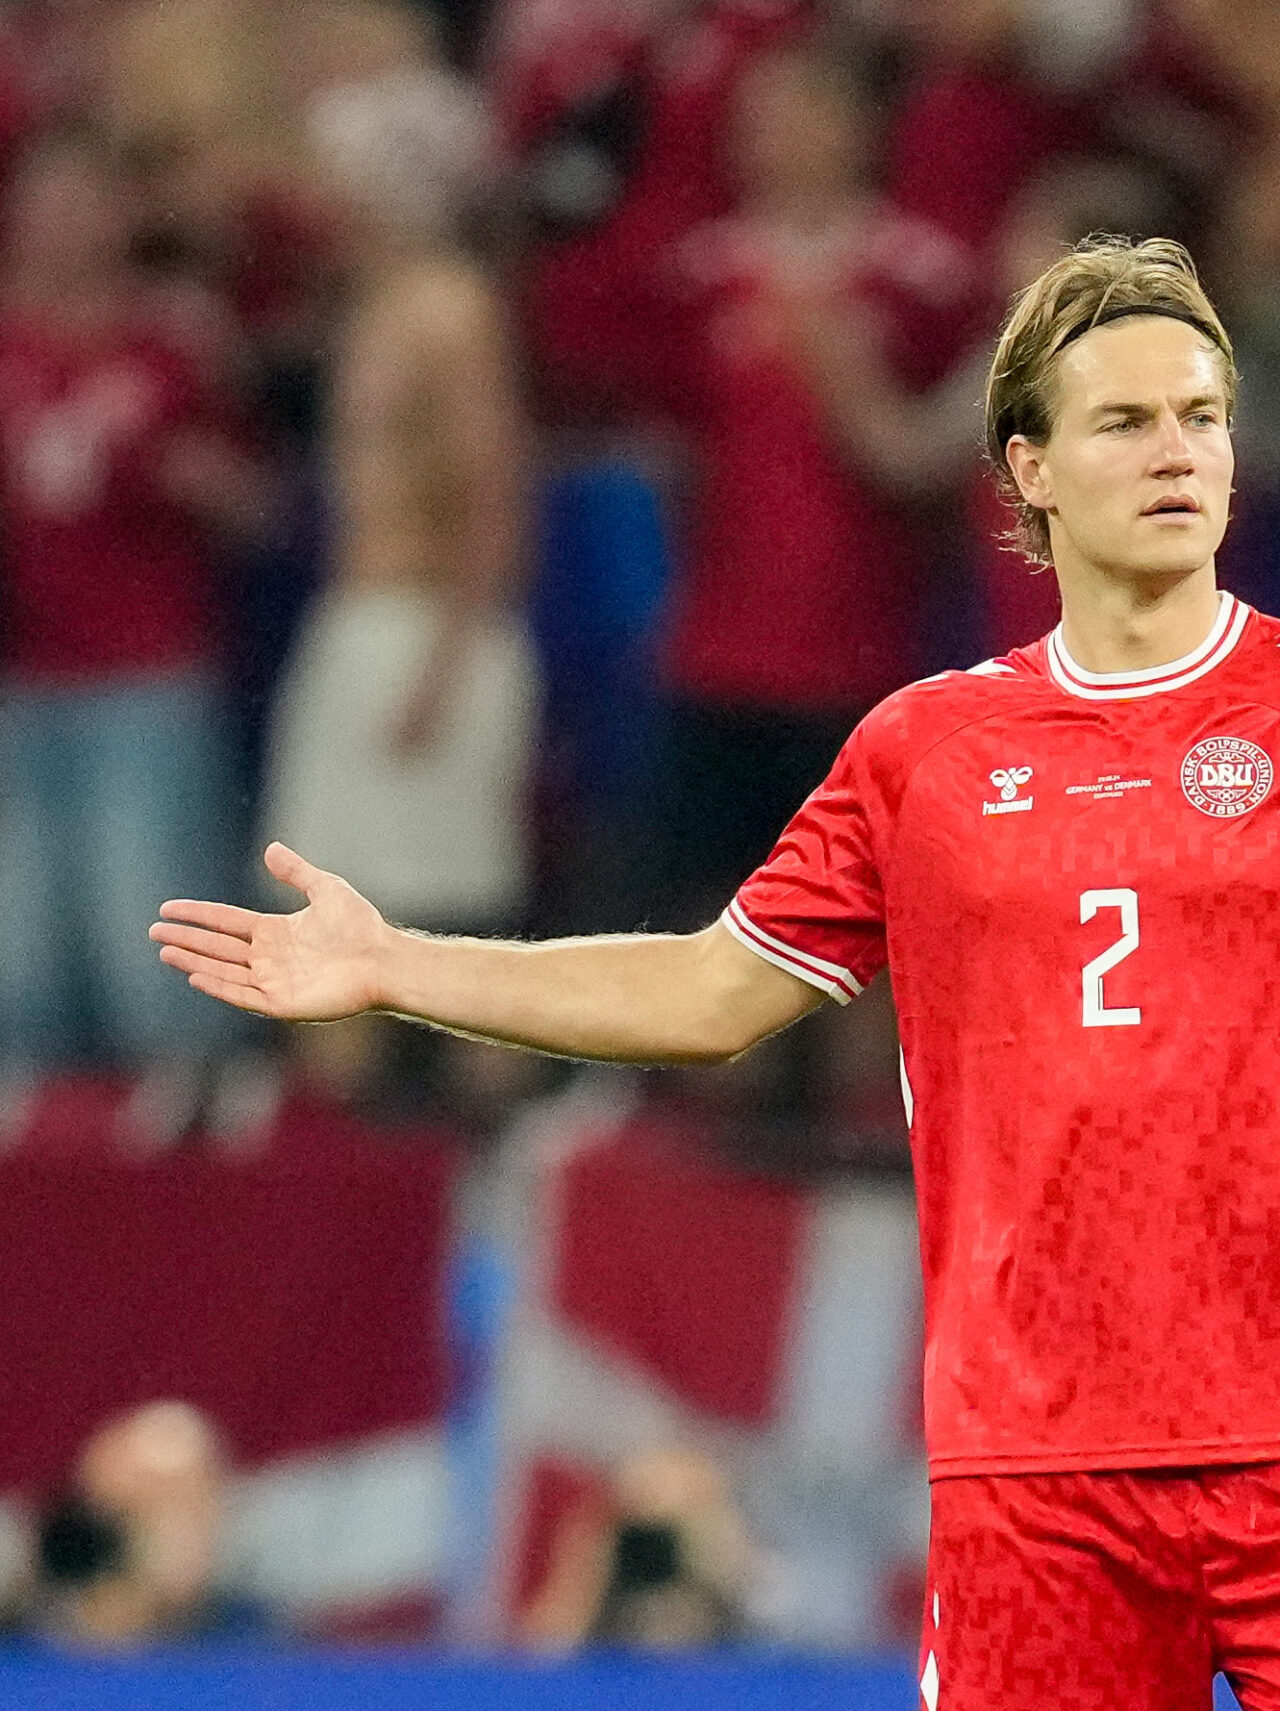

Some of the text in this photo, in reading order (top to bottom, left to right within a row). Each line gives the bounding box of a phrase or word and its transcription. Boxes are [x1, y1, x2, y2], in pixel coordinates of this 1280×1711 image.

[1066, 784, 1103, 795] GERMANY
[1114, 779, 1152, 791] DENMARK
[1185, 757, 1205, 806] DANSK
[1249, 759, 1270, 803] UNION
[1199, 764, 1254, 787] DBU
[1208, 802, 1246, 815] 1889
[1080, 889, 1141, 1028] 2
